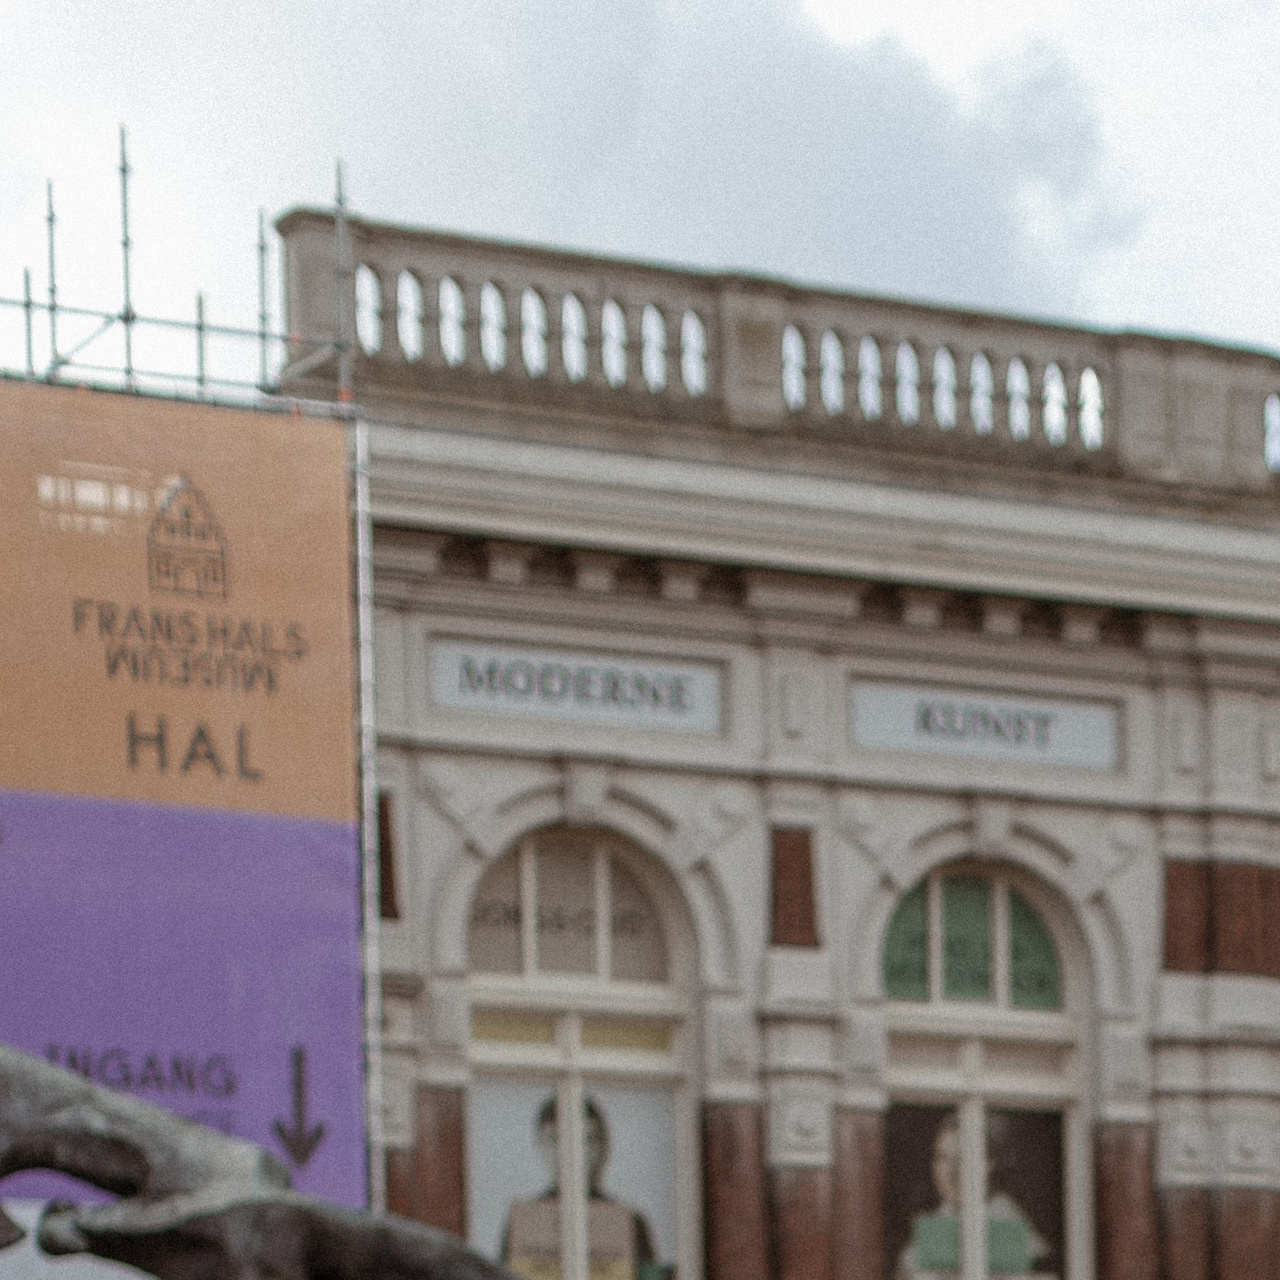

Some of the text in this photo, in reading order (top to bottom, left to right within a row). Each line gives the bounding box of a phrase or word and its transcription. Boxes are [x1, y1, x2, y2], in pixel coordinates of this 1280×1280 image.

[73, 600, 308, 660] FRANS HALS
[458, 653, 691, 715] MODERNE
[914, 700, 1055, 749] KUNST
[127, 712, 263, 780] HAL
